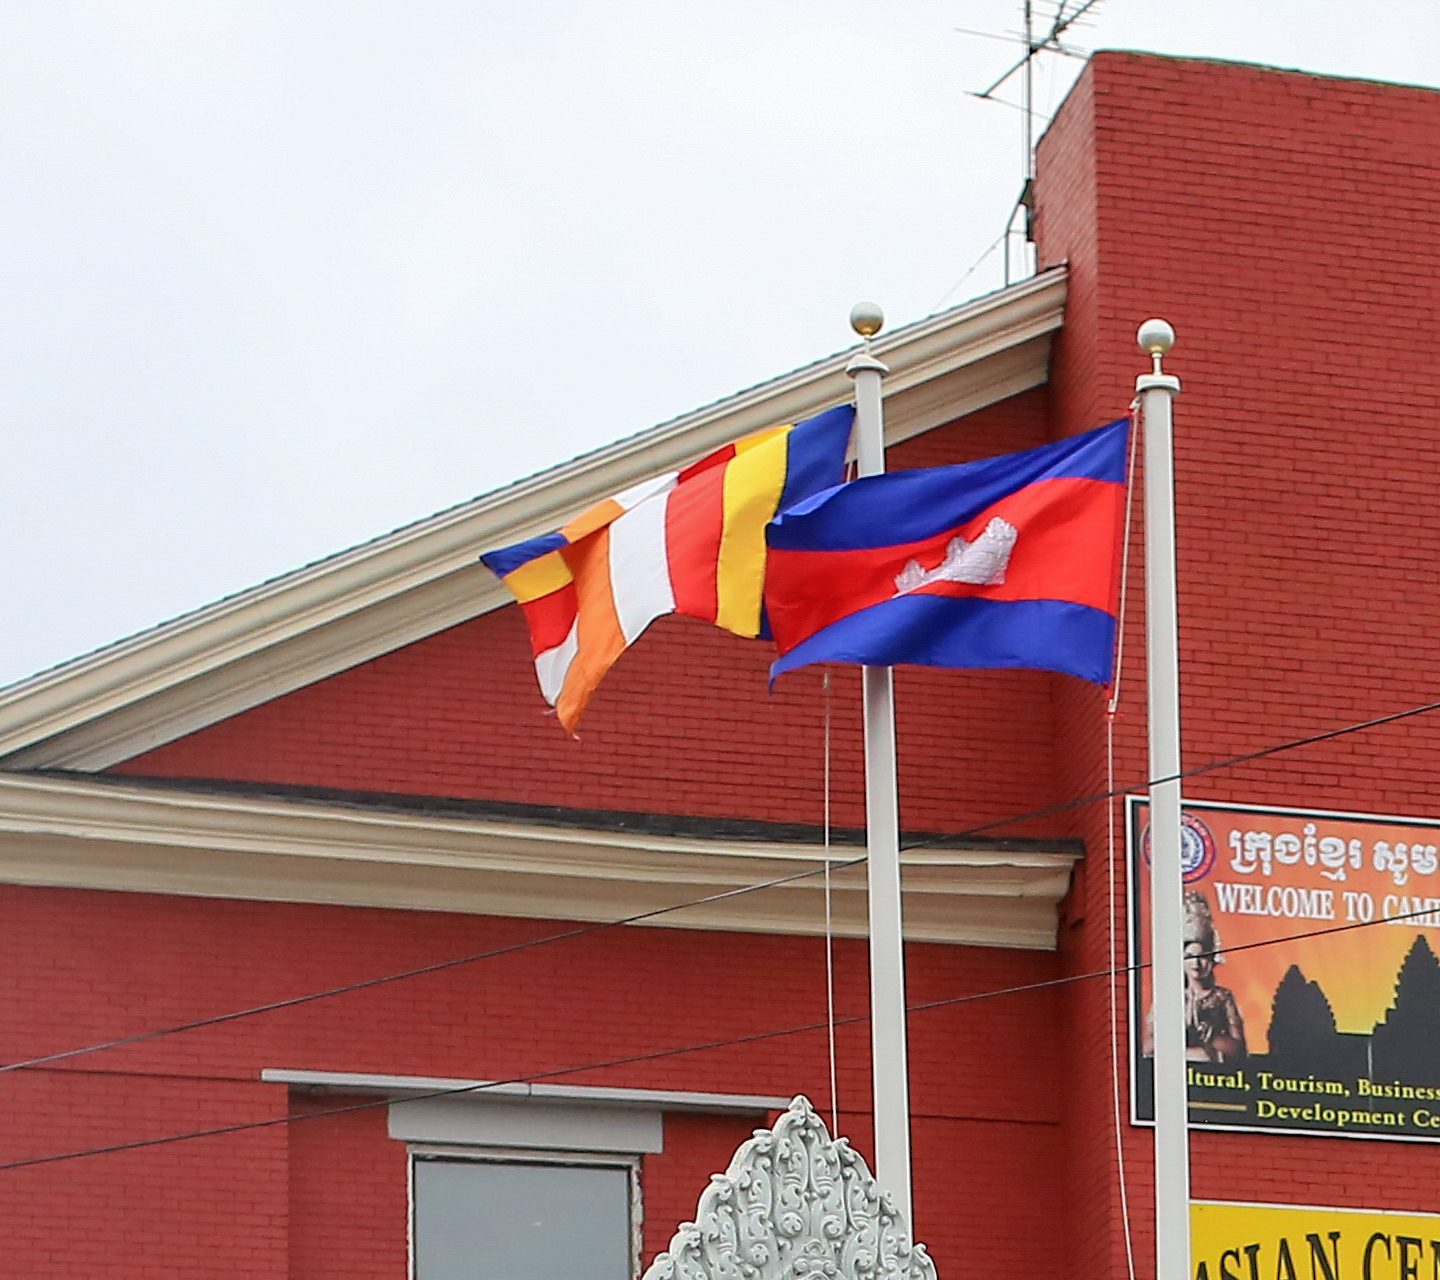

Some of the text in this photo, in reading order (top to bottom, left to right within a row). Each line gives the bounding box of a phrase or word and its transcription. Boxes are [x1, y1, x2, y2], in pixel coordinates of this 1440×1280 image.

[1213, 882, 1335, 920] WELCOME
[1342, 892, 1374, 922] TO
[1256, 1072, 1351, 1098] Tourism,
[1256, 1100, 1406, 1128] Development
